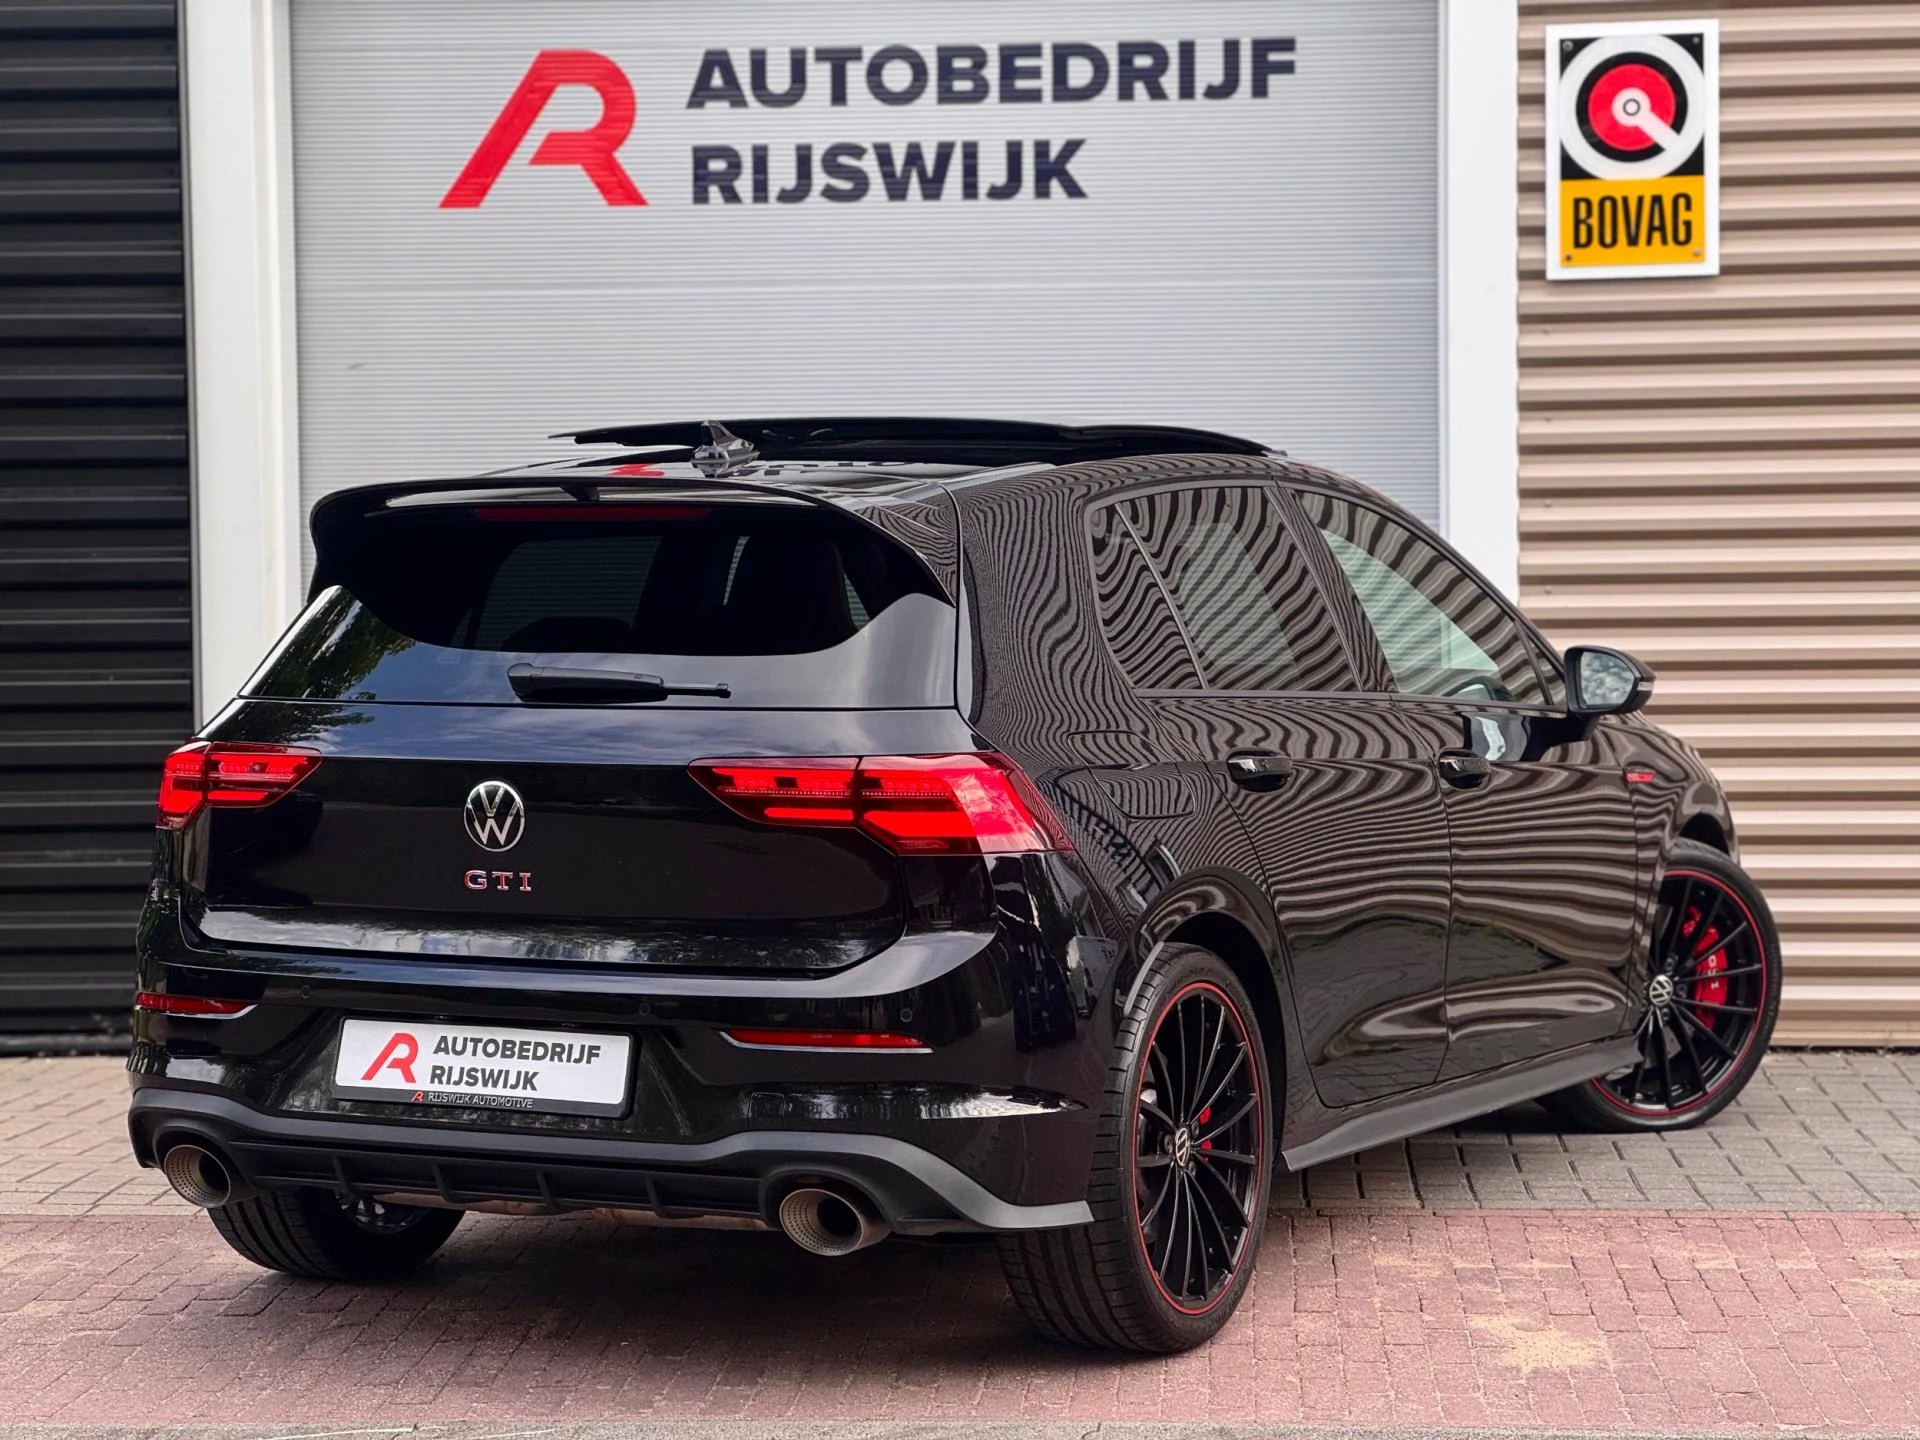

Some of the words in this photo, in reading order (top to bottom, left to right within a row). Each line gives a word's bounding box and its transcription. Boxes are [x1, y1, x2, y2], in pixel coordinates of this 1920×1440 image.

[686, 37, 1297, 110] AUTOBEDRIJF
[692, 138, 1088, 206] RIJSWIJK
[1573, 192, 1693, 249] BOVAG
[464, 869, 532, 892] GTI
[433, 1035, 601, 1065] AUTOBEDRIJF
[429, 1064, 540, 1092] RIJSWIJK
[428, 1092, 472, 1104] RIJSWIJK
[472, 1095, 535, 1109] AUTOMOTIVE
